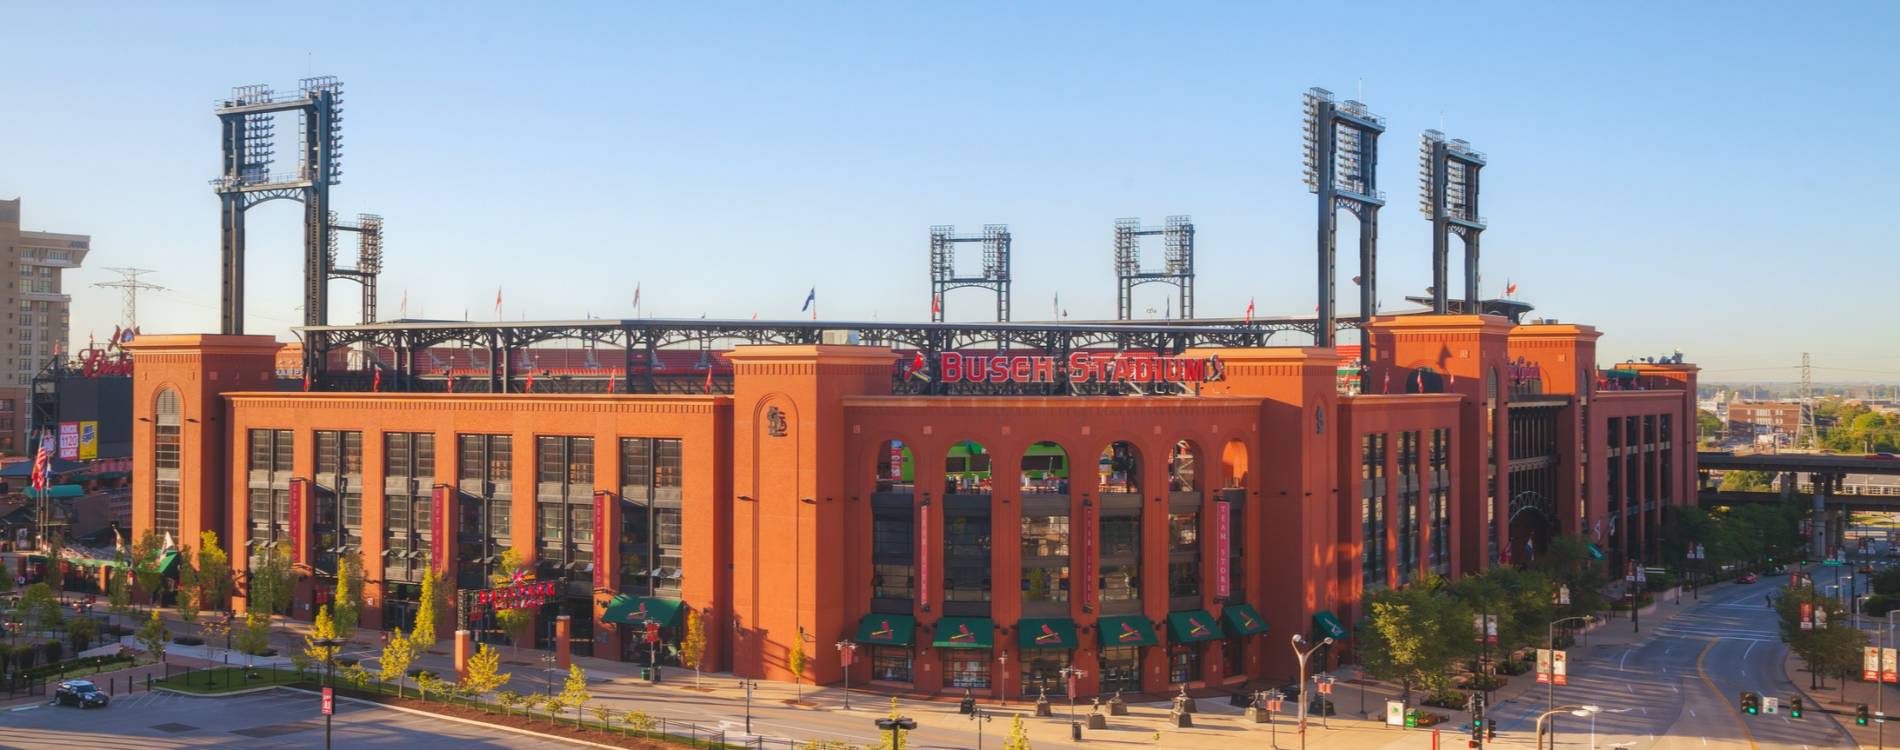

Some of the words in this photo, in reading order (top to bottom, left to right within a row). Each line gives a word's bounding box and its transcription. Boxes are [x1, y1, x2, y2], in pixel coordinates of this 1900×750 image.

[941, 351, 1054, 383] BUSCH
[1069, 351, 1204, 383] STADIUM
[479, 581, 555, 605] BALLPARK
